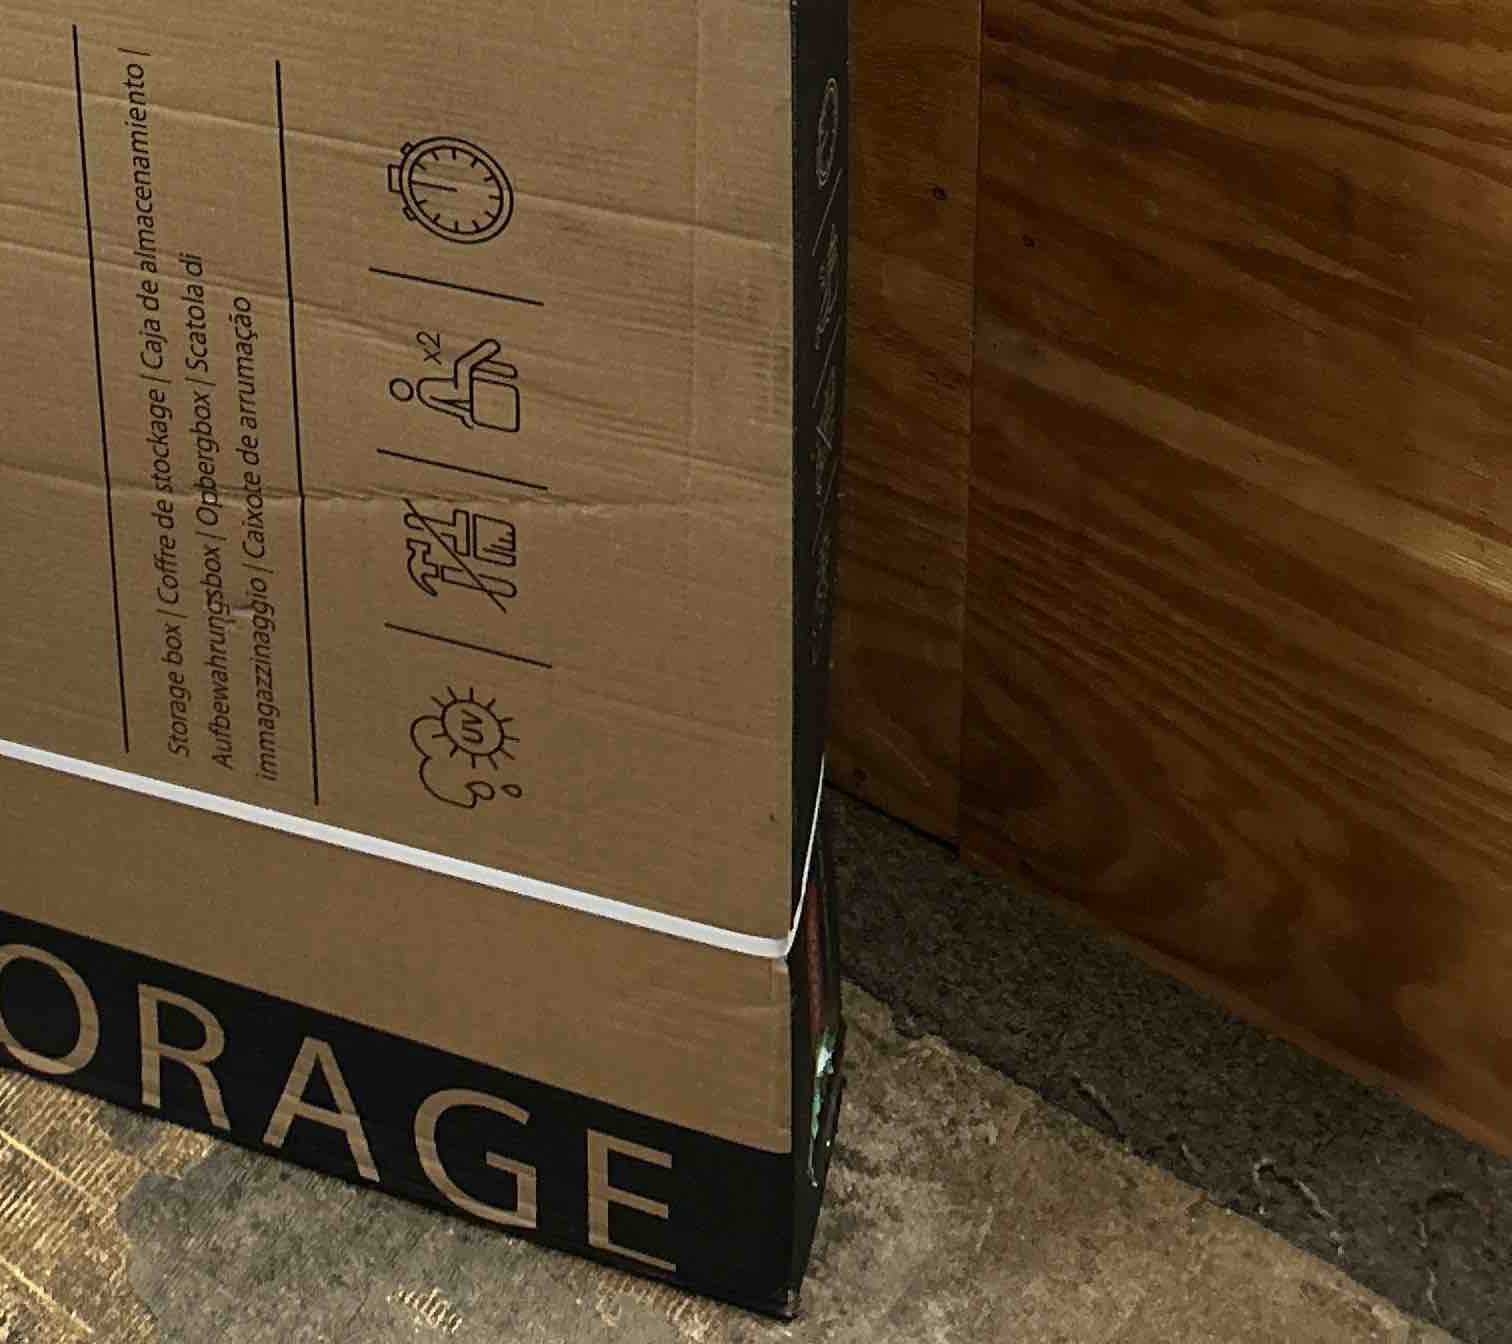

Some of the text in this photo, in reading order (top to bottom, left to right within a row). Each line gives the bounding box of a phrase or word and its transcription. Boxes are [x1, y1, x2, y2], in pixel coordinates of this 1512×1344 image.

[122, 63, 157, 273] almacenamiento
[136, 280, 160, 312] de
[179, 252, 203, 278] di
[139, 317, 168, 370] Caja
[183, 285, 209, 374] Scatola
[228, 296, 259, 431] arrumação
[415, 330, 442, 365] x2
[147, 386, 173, 493] stockage
[191, 391, 221, 527] Opbergbox
[235, 434, 259, 467] de
[152, 499, 174, 531] de
[238, 474, 266, 561] Caixote
[155, 534, 180, 606] Coffre
[162, 623, 184, 665] box
[196, 544, 232, 772] Aufbewahrungsbox
[243, 576, 281, 782] immagazzinaggio
[167, 669, 194, 758] Storage
[460, 708, 484, 744] UV
